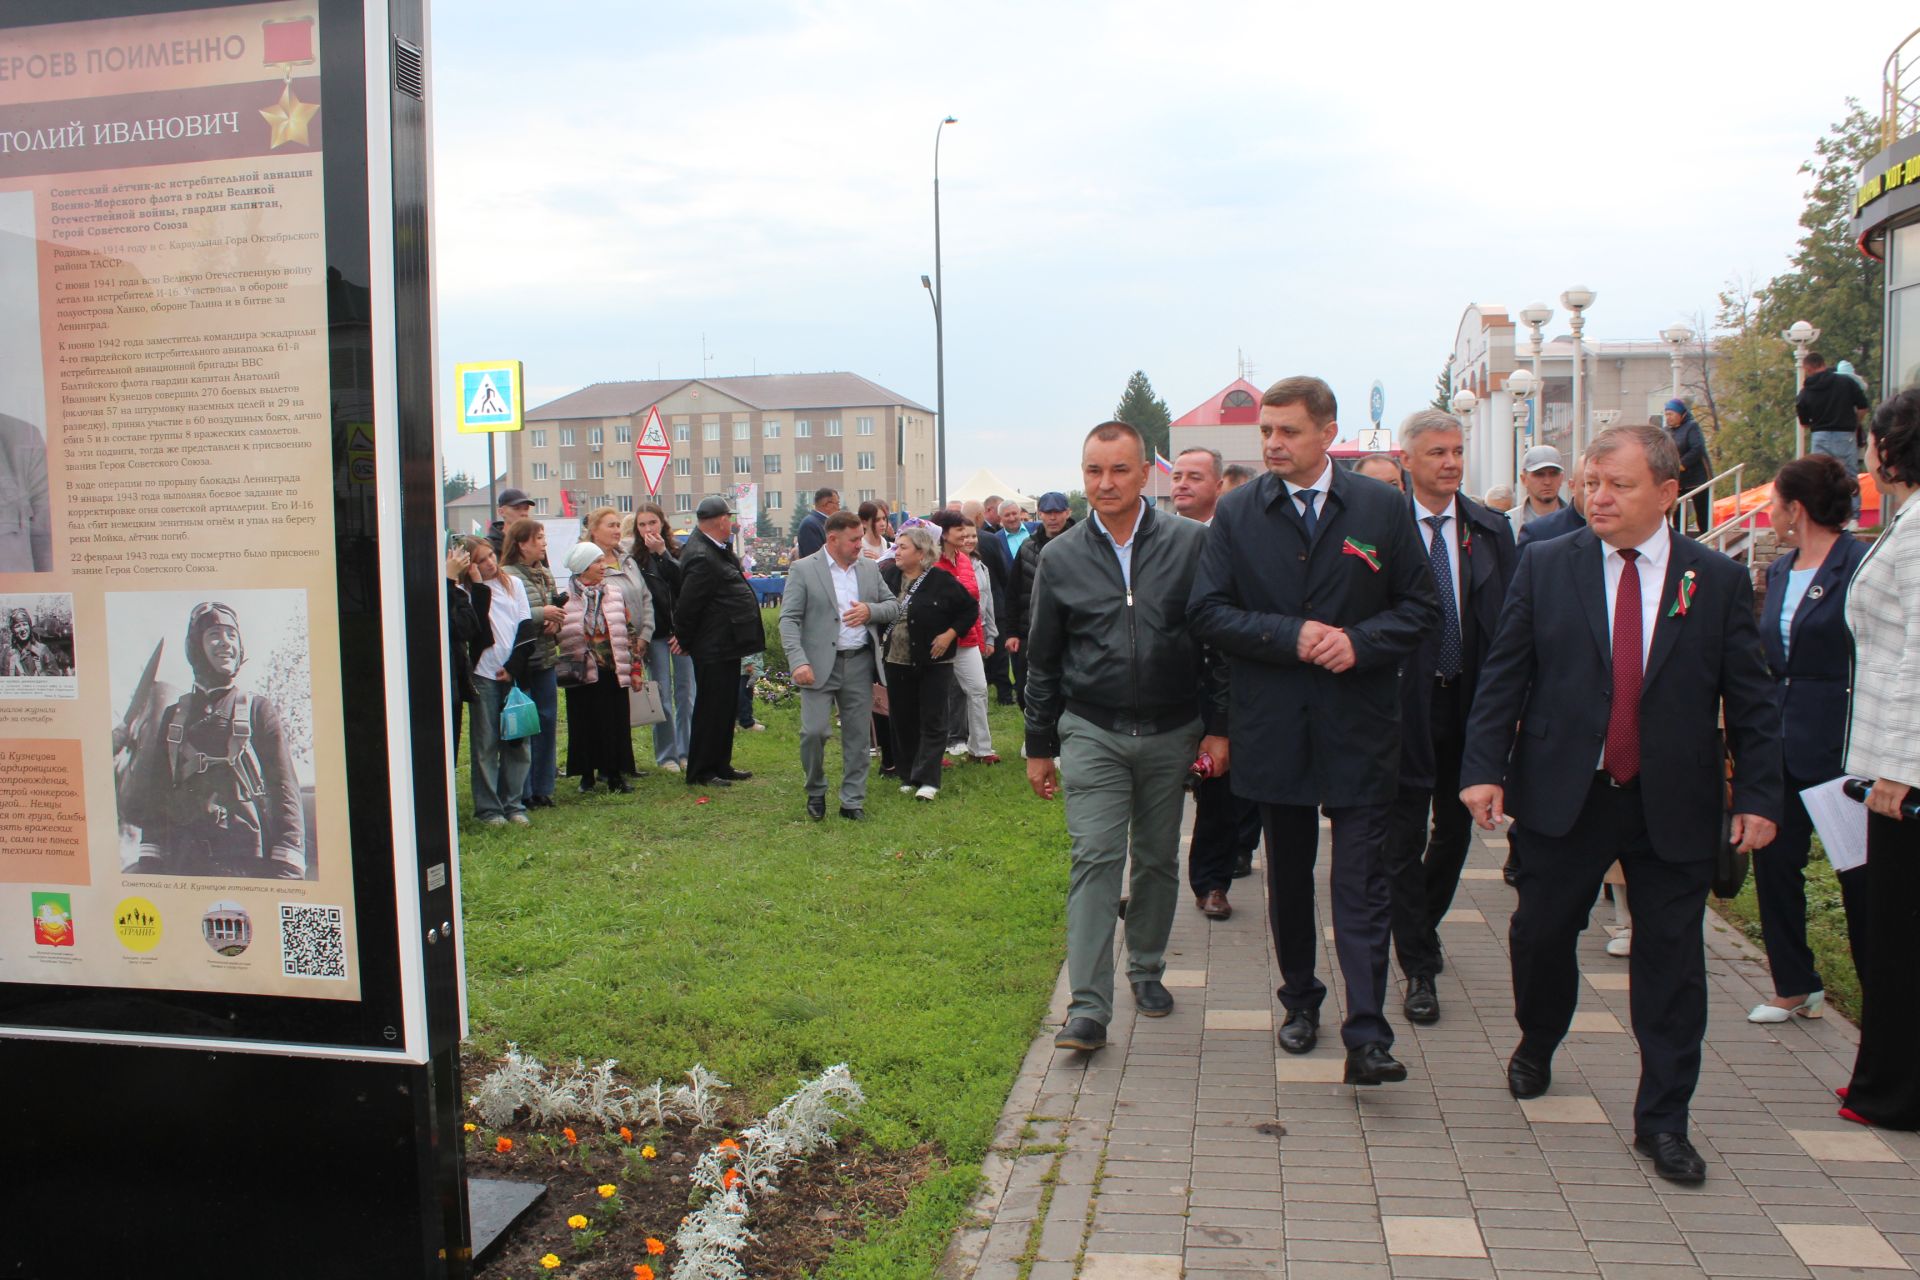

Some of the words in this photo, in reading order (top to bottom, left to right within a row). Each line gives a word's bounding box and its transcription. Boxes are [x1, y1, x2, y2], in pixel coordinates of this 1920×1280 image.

[87, 35, 246, 74] ПОИМЕННО
[93, 111, 240, 146] ИВАНОВИЧ
[50, 184, 108, 198] Советский
[112, 181, 166, 193] лётчик-ас
[169, 171, 260, 189] истребительной
[263, 169, 313, 180] авиации
[51, 198, 146, 211] Военно-Морского
[150, 194, 182, 206] флота
[196, 191, 223, 200] годы
[227, 185, 275, 197] Великой
[51, 211, 135, 225] Отечественной
[182, 205, 226, 216] гвардии
[52, 228, 84, 240] Герой
[88, 225, 150, 236] Советского
[153, 221, 188, 230] Союза
